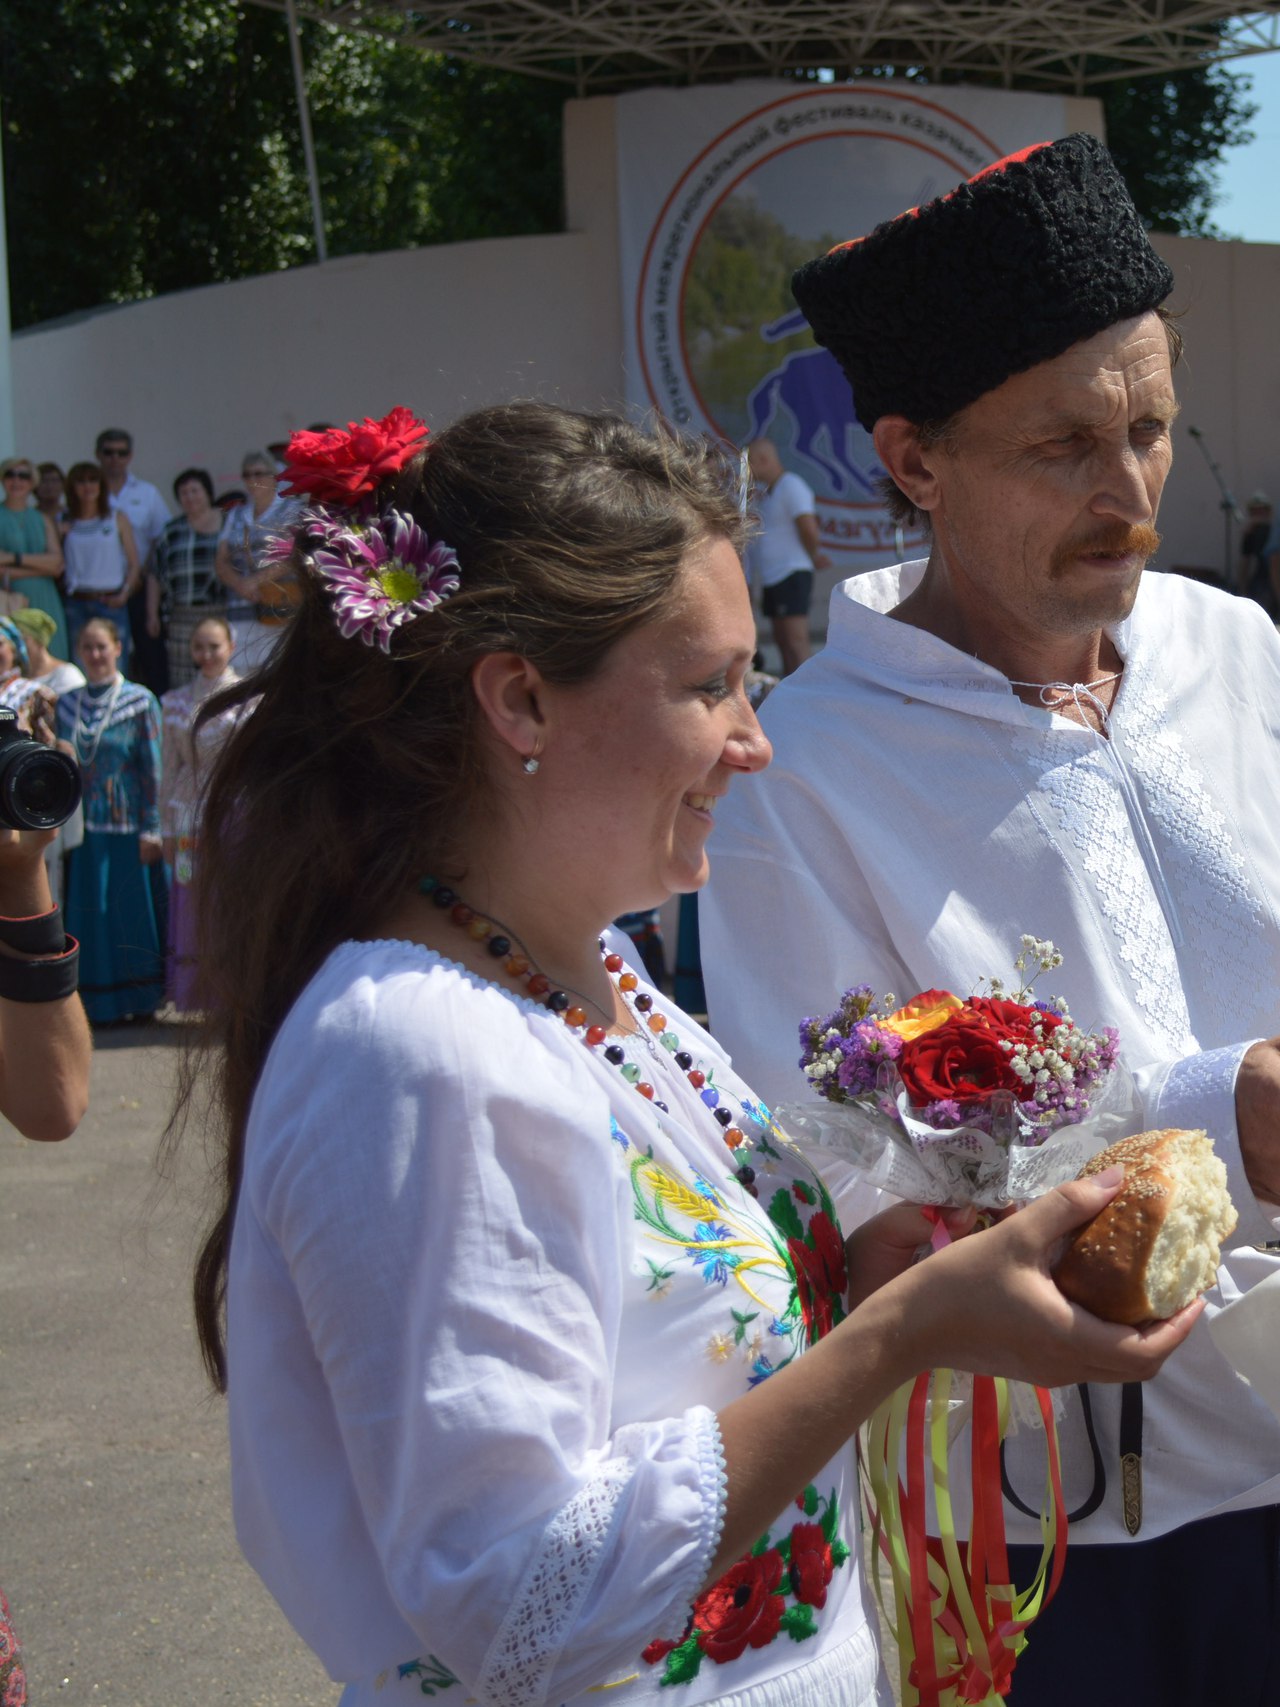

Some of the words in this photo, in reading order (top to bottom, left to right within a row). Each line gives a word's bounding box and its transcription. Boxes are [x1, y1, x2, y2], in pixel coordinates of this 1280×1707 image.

[773, 104, 895, 135] фестиваль
[656, 124, 771, 304] межрегиональный
[653, 311, 691, 424] Открытый
